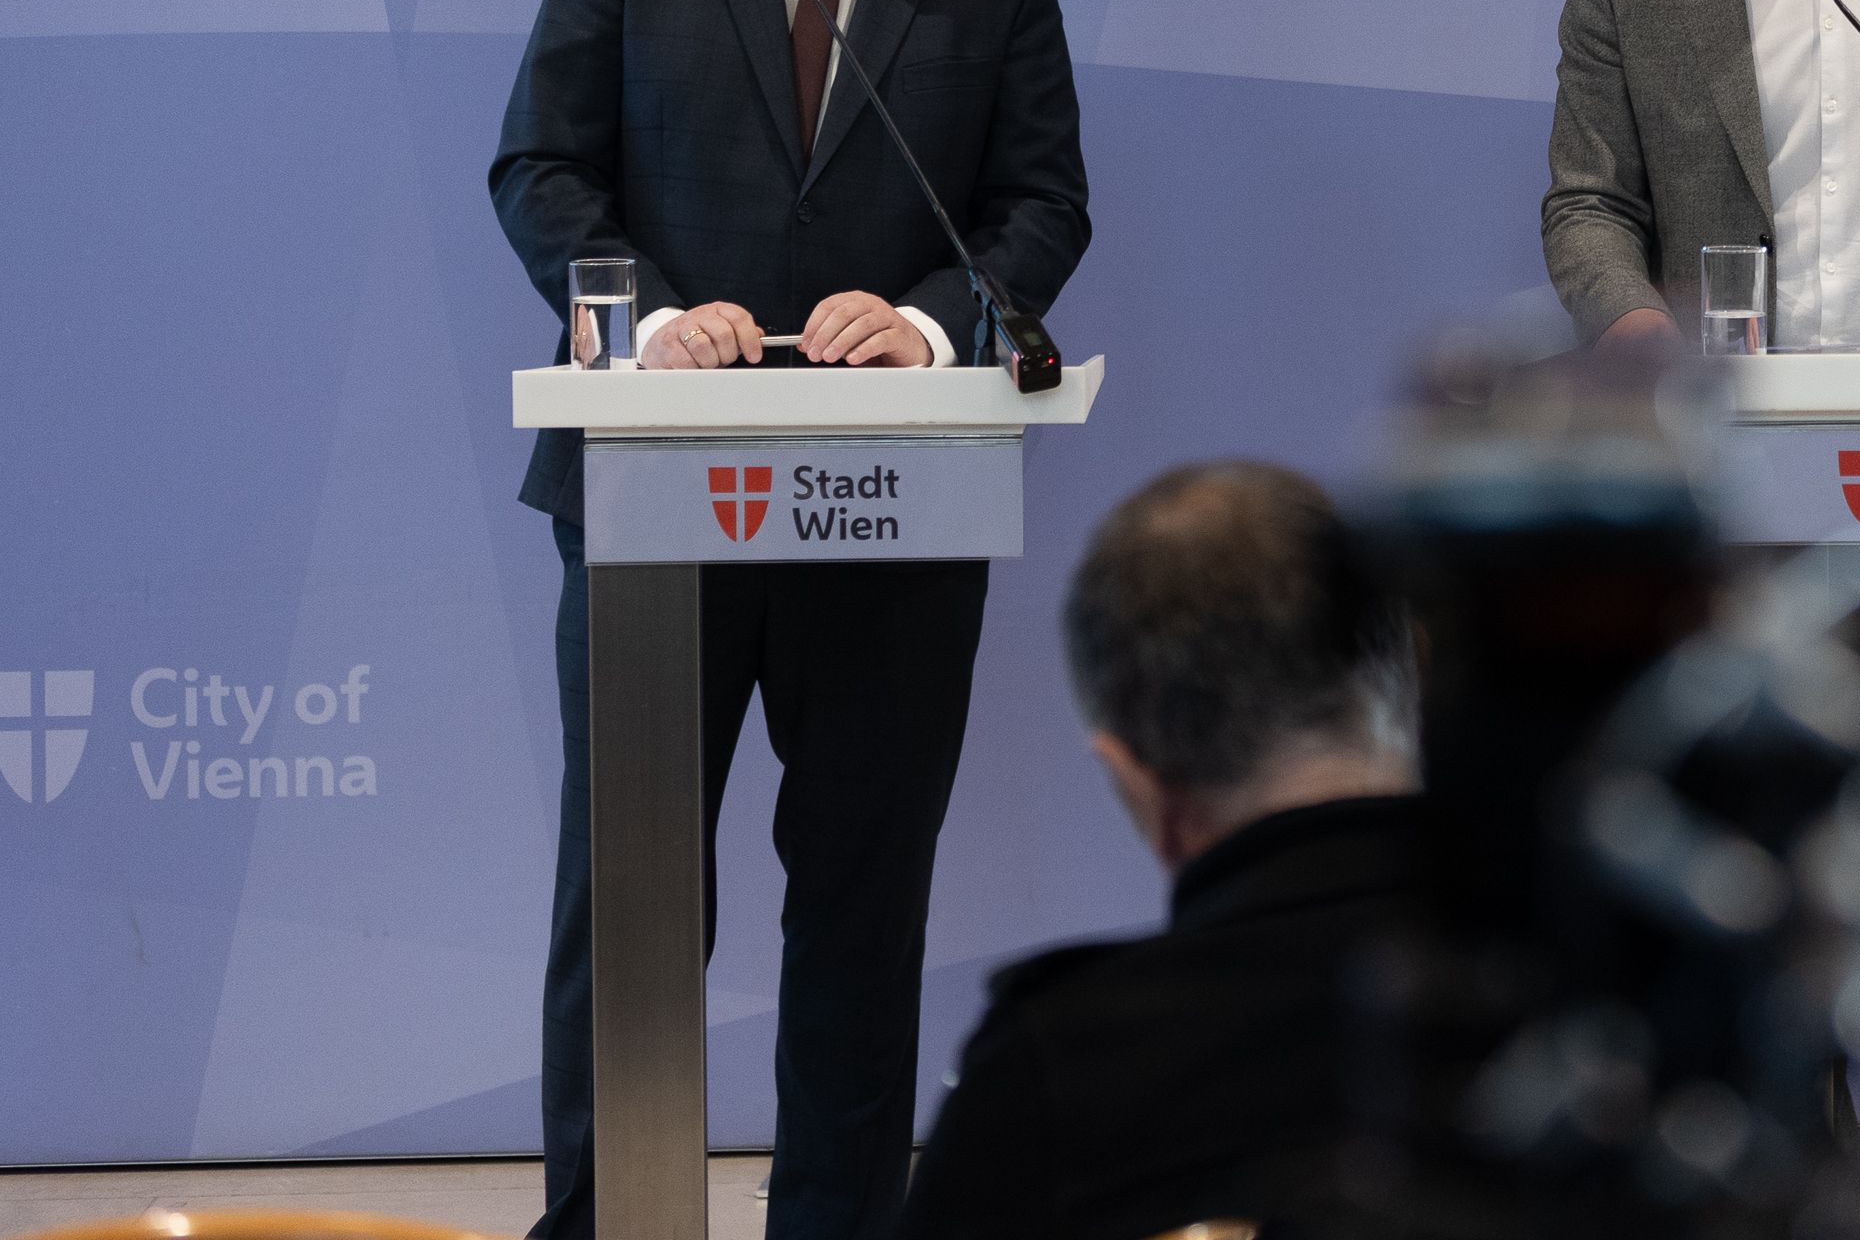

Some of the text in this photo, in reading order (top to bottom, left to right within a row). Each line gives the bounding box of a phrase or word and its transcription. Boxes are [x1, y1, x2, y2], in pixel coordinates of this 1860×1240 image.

[793, 465, 899, 500] Stadt
[792, 507, 899, 540] Wien
[130, 664, 371, 744] City of
[130, 740, 377, 800] Vienna
